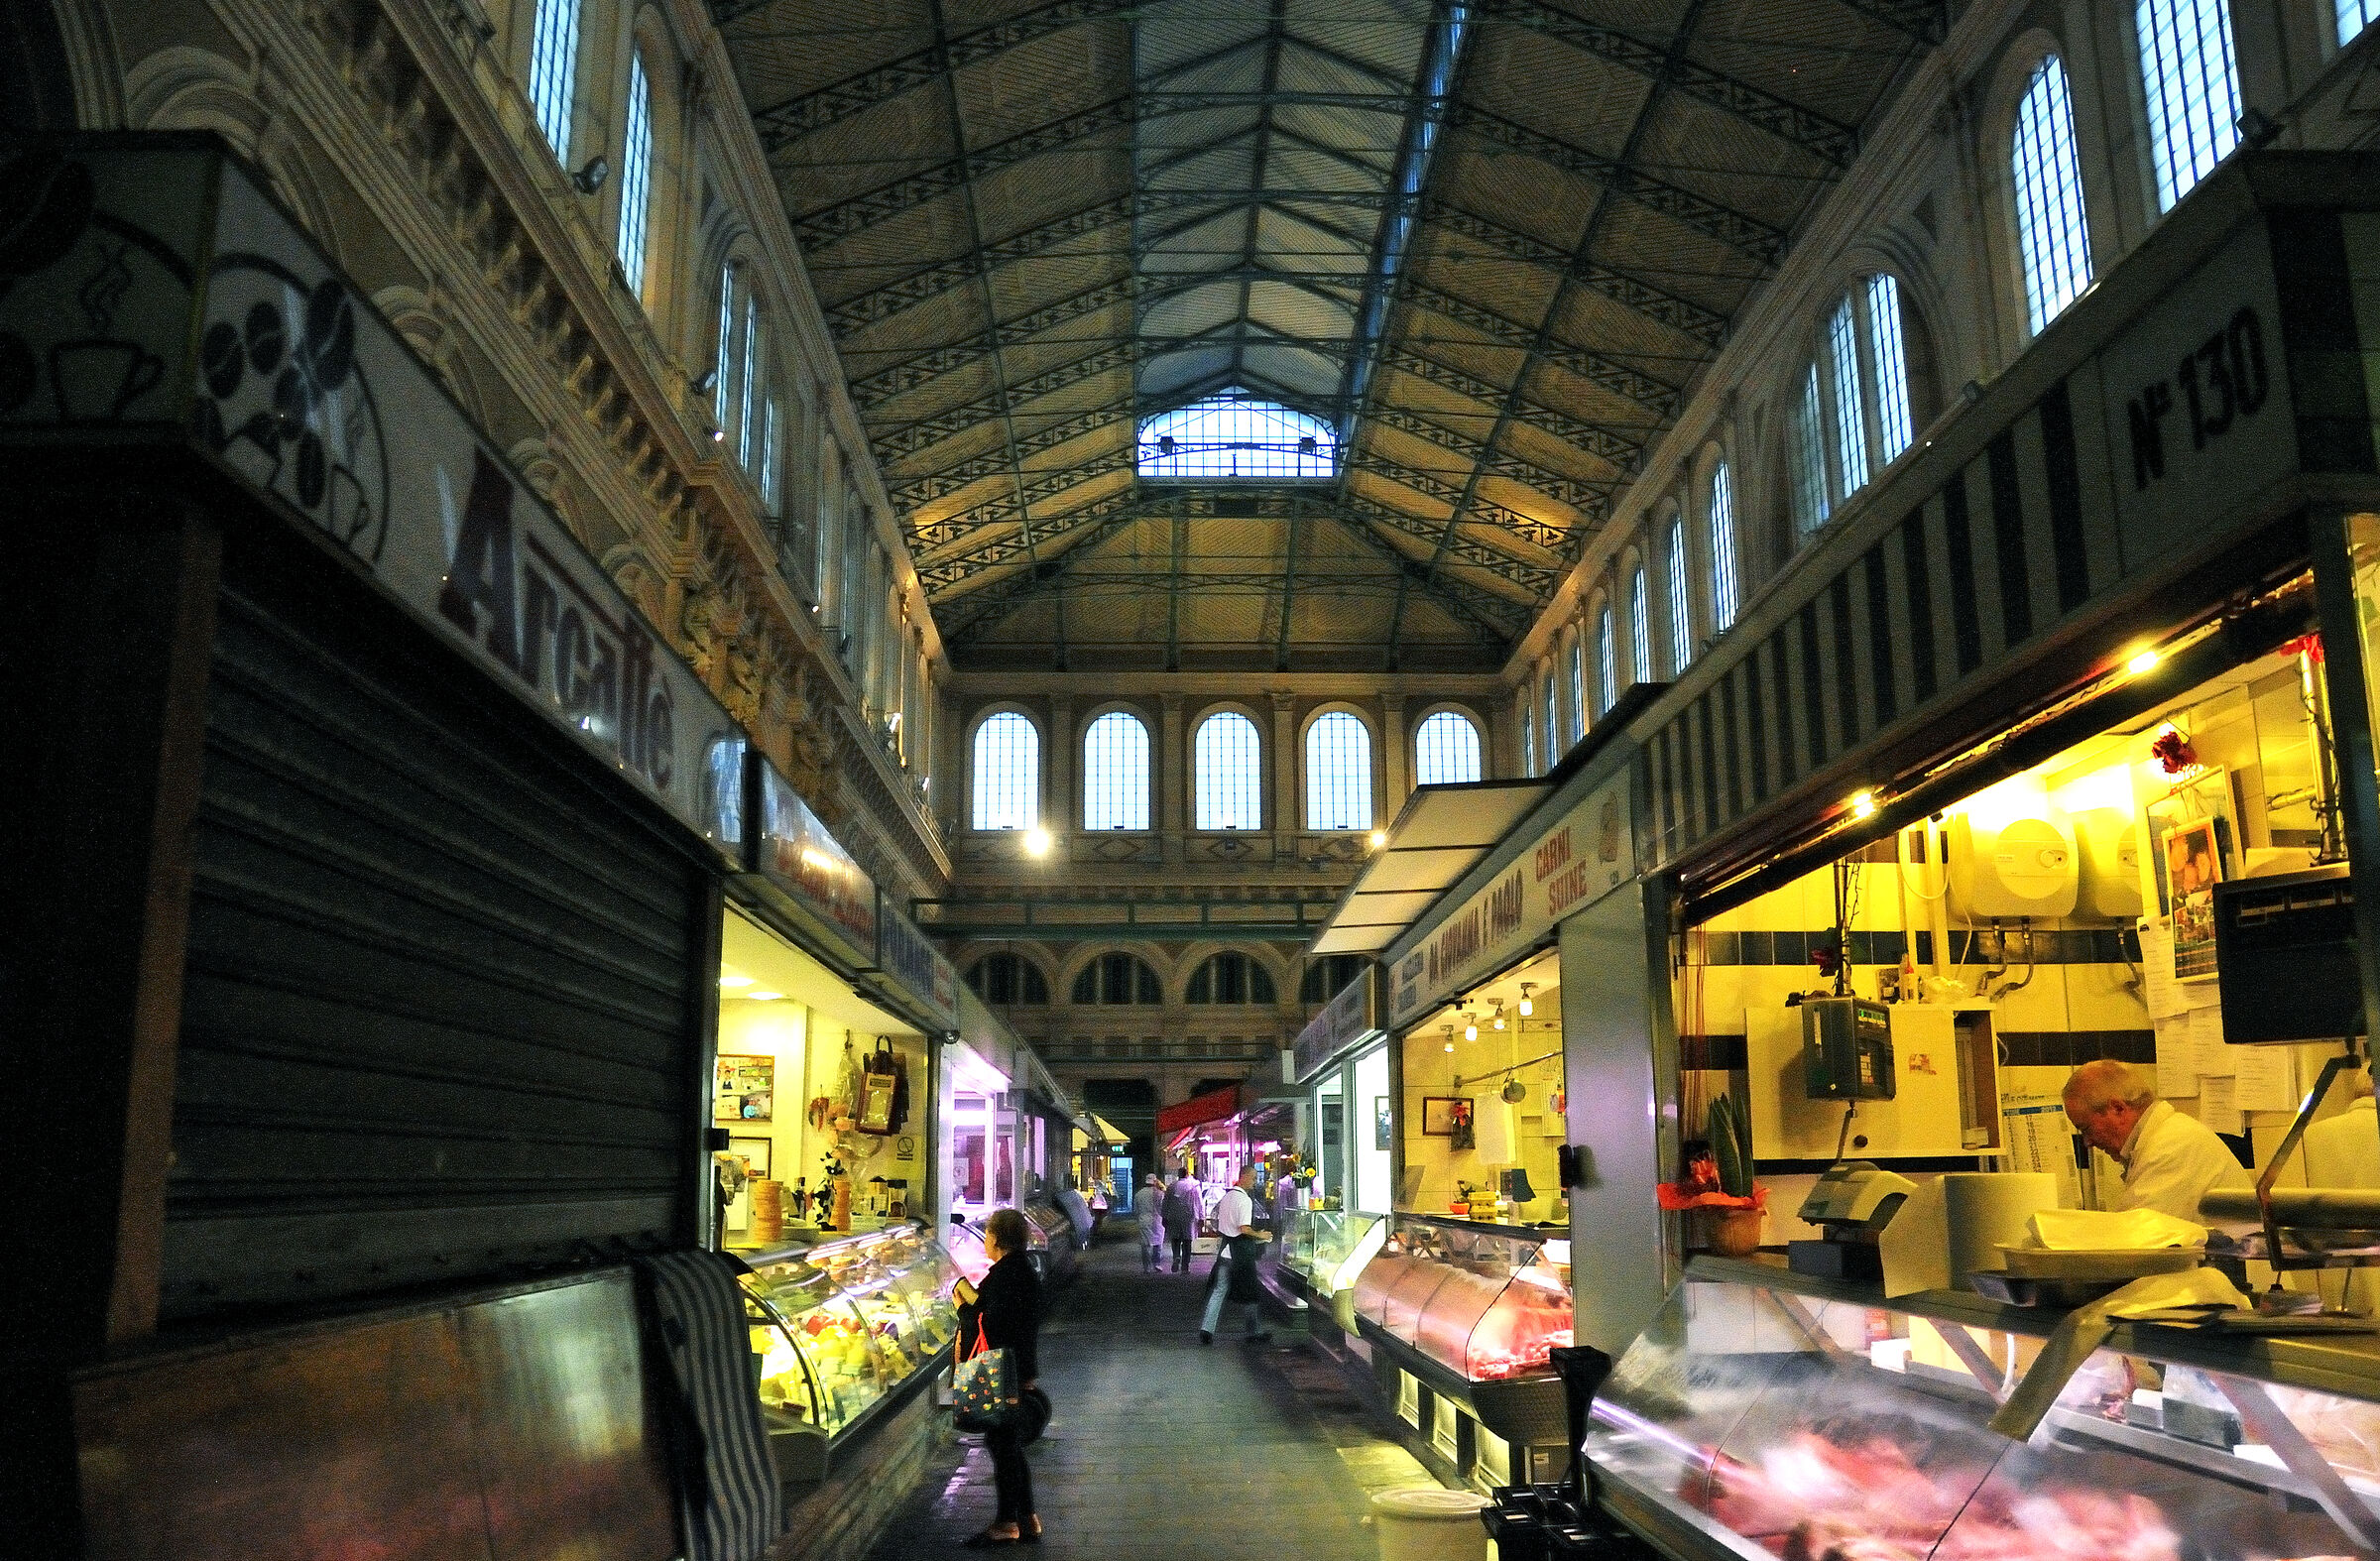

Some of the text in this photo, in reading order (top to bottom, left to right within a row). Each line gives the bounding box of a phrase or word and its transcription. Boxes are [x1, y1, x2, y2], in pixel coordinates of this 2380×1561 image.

[2179, 305, 2270, 450] 130
[1536, 826, 1571, 883] CARNI
[1549, 859, 1588, 916] SUINE
